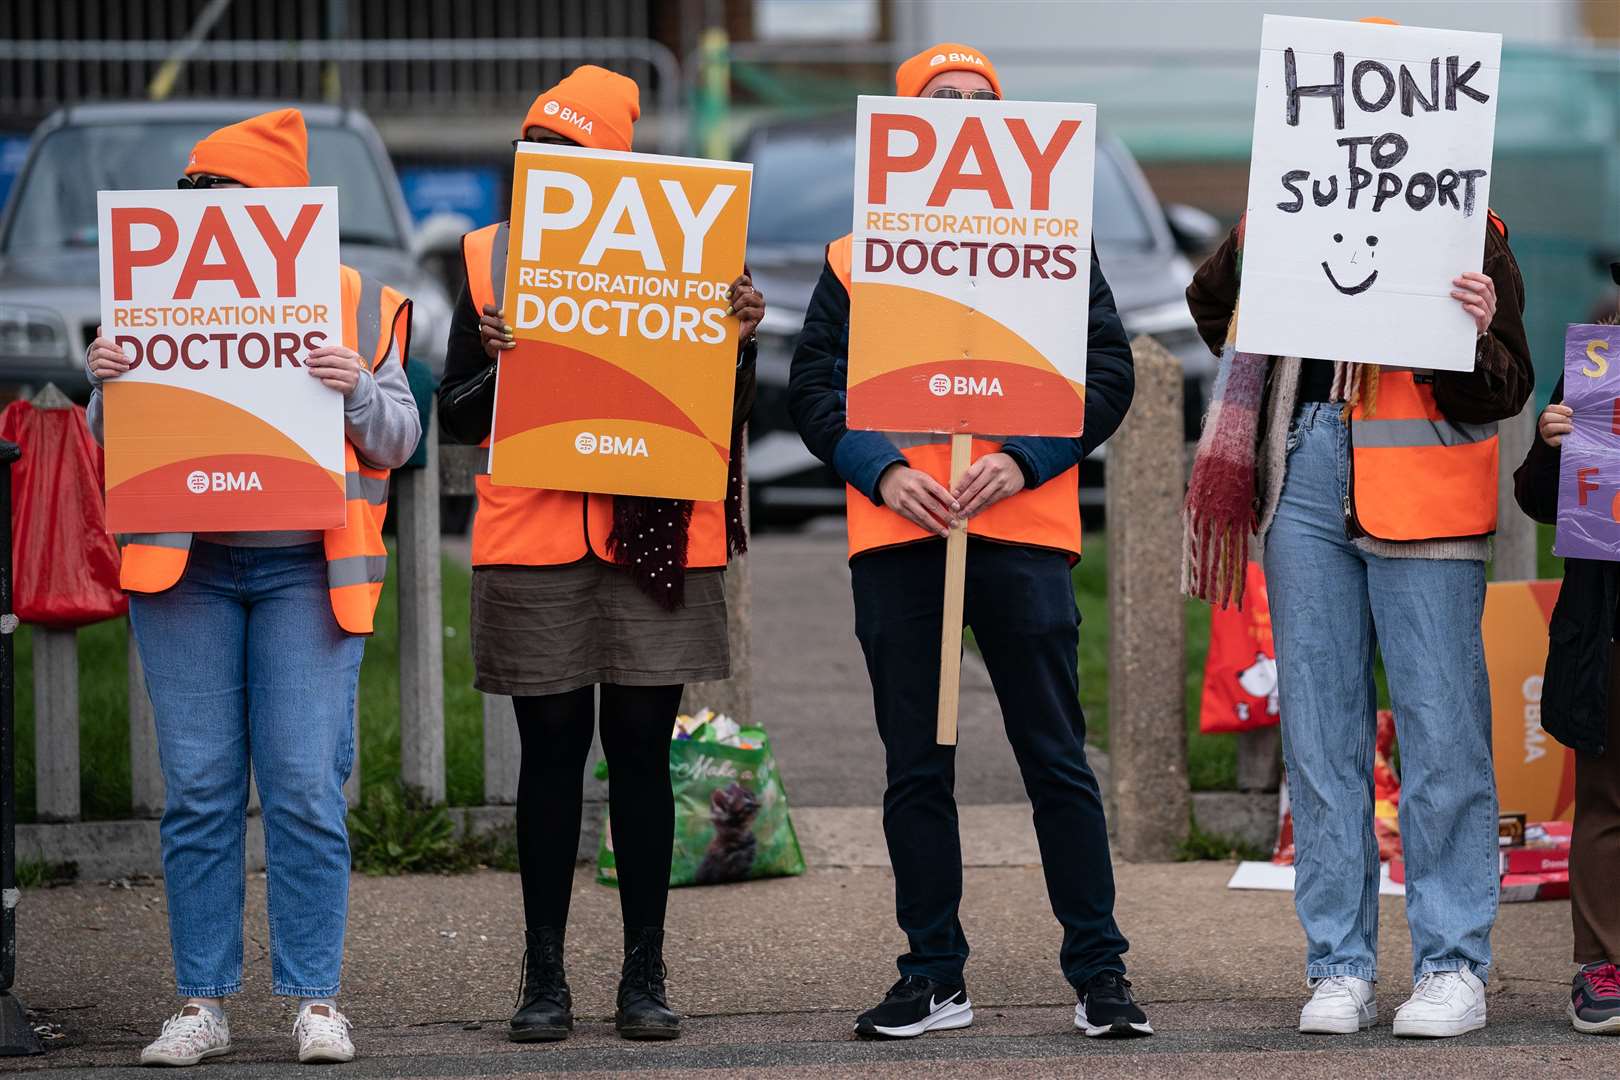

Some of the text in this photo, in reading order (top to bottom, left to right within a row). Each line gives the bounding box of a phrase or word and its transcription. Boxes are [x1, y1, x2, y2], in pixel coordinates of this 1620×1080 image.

[949, 53, 984, 66] BMA
[1284, 47, 1489, 130] HONK
[560, 107, 593, 135] BMA
[868, 113, 1082, 211] PAY
[1336, 132, 1408, 170] TO
[1276, 168, 1487, 218] SUPPORT
[521, 169, 736, 274] PAY
[866, 211, 1079, 238] RESTORATION FOR
[111, 204, 324, 301] PAY
[865, 238, 1077, 280] DOCTORS
[518, 267, 729, 302] RESTORATION FOR
[114, 304, 328, 327] RESTORATION FOR
[515, 296, 726, 345] DOCTORS
[953, 376, 1004, 397] BMA
[598, 435, 649, 458] BMA
[211, 471, 262, 492] BMA
